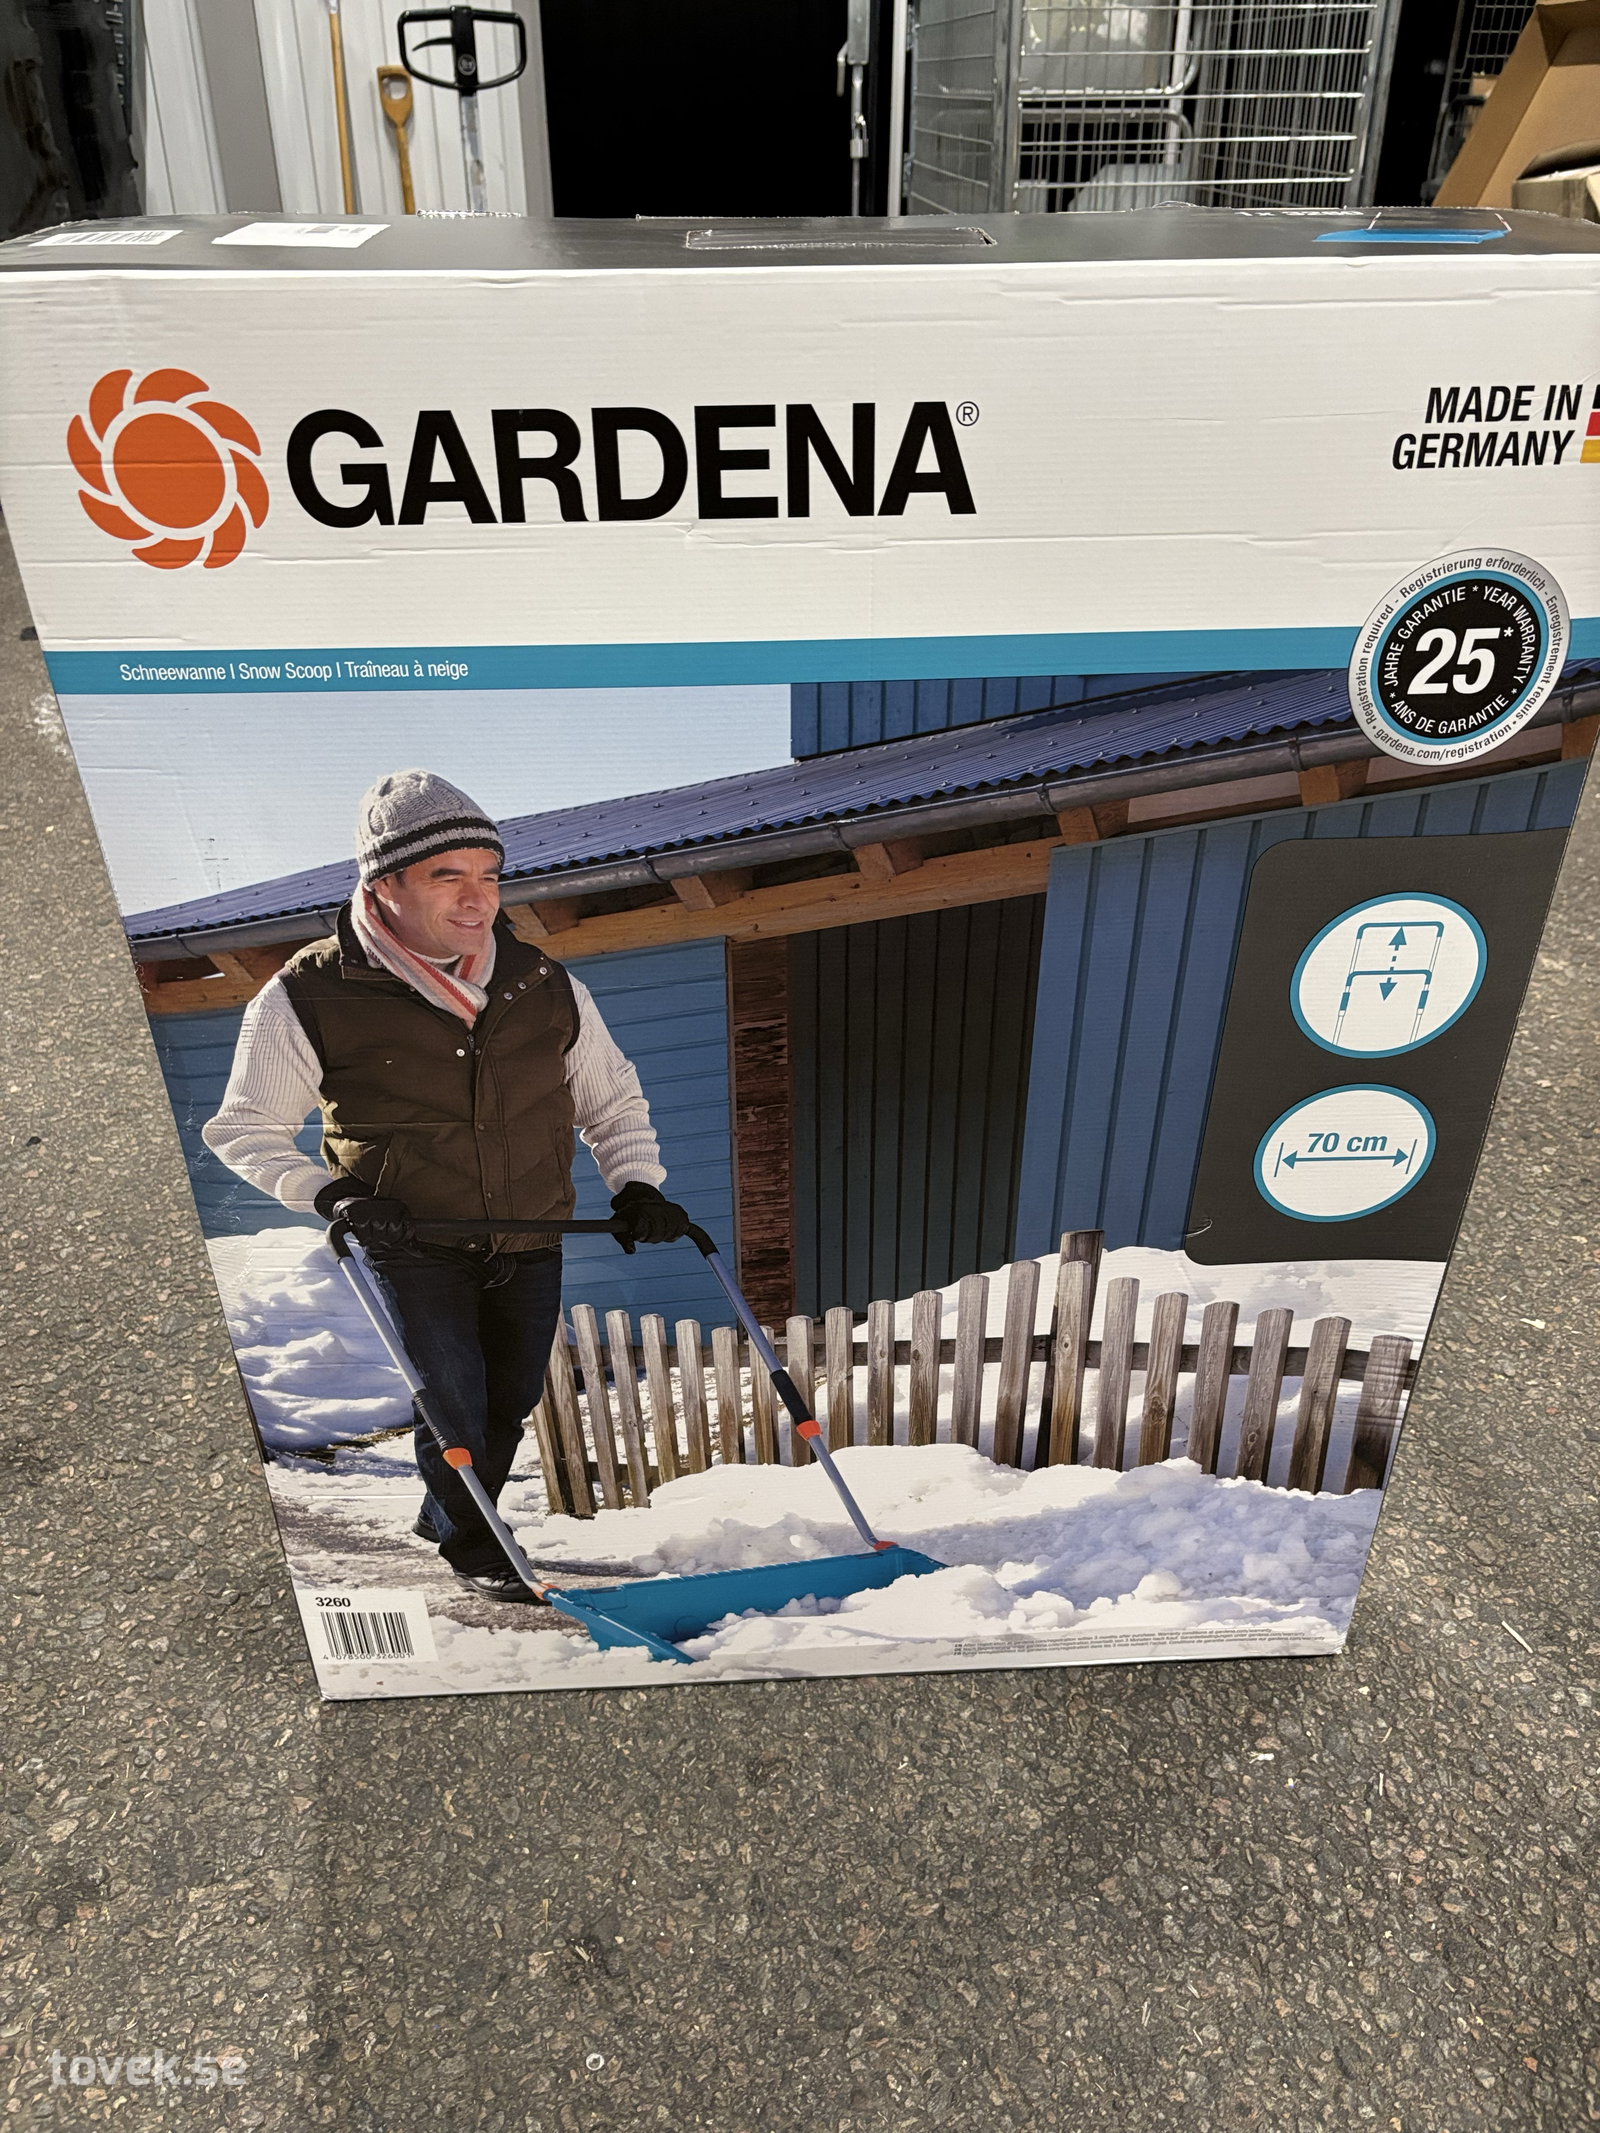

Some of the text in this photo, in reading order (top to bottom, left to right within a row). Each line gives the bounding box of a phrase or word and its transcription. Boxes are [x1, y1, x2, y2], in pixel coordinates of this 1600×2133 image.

[1425, 384, 1583, 423] MADE IN
[1392, 430, 1575, 470] GERMANY
[1356, 557, 1563, 725] Registration required Registrierung erforderlich Enregistrement requis
[1384, 586, 1466, 687] JAHRE GARANTIE
[1483, 585, 1536, 684] YEAR WARRANTY
[119, 664, 226, 681] Schneewanne
[239, 662, 280, 679] Snow
[285, 662, 332, 682] Scoop
[343, 660, 409, 678] Traîneau
[414, 660, 424, 677] à
[428, 661, 468, 680] neige
[1391, 694, 1509, 734] ANS DE GARANTIE
[1374, 724, 1512, 761] gardena.com/registration
[1307, 1132, 1388, 1153] 70 cm
[315, 1596, 351, 1607] 3260
